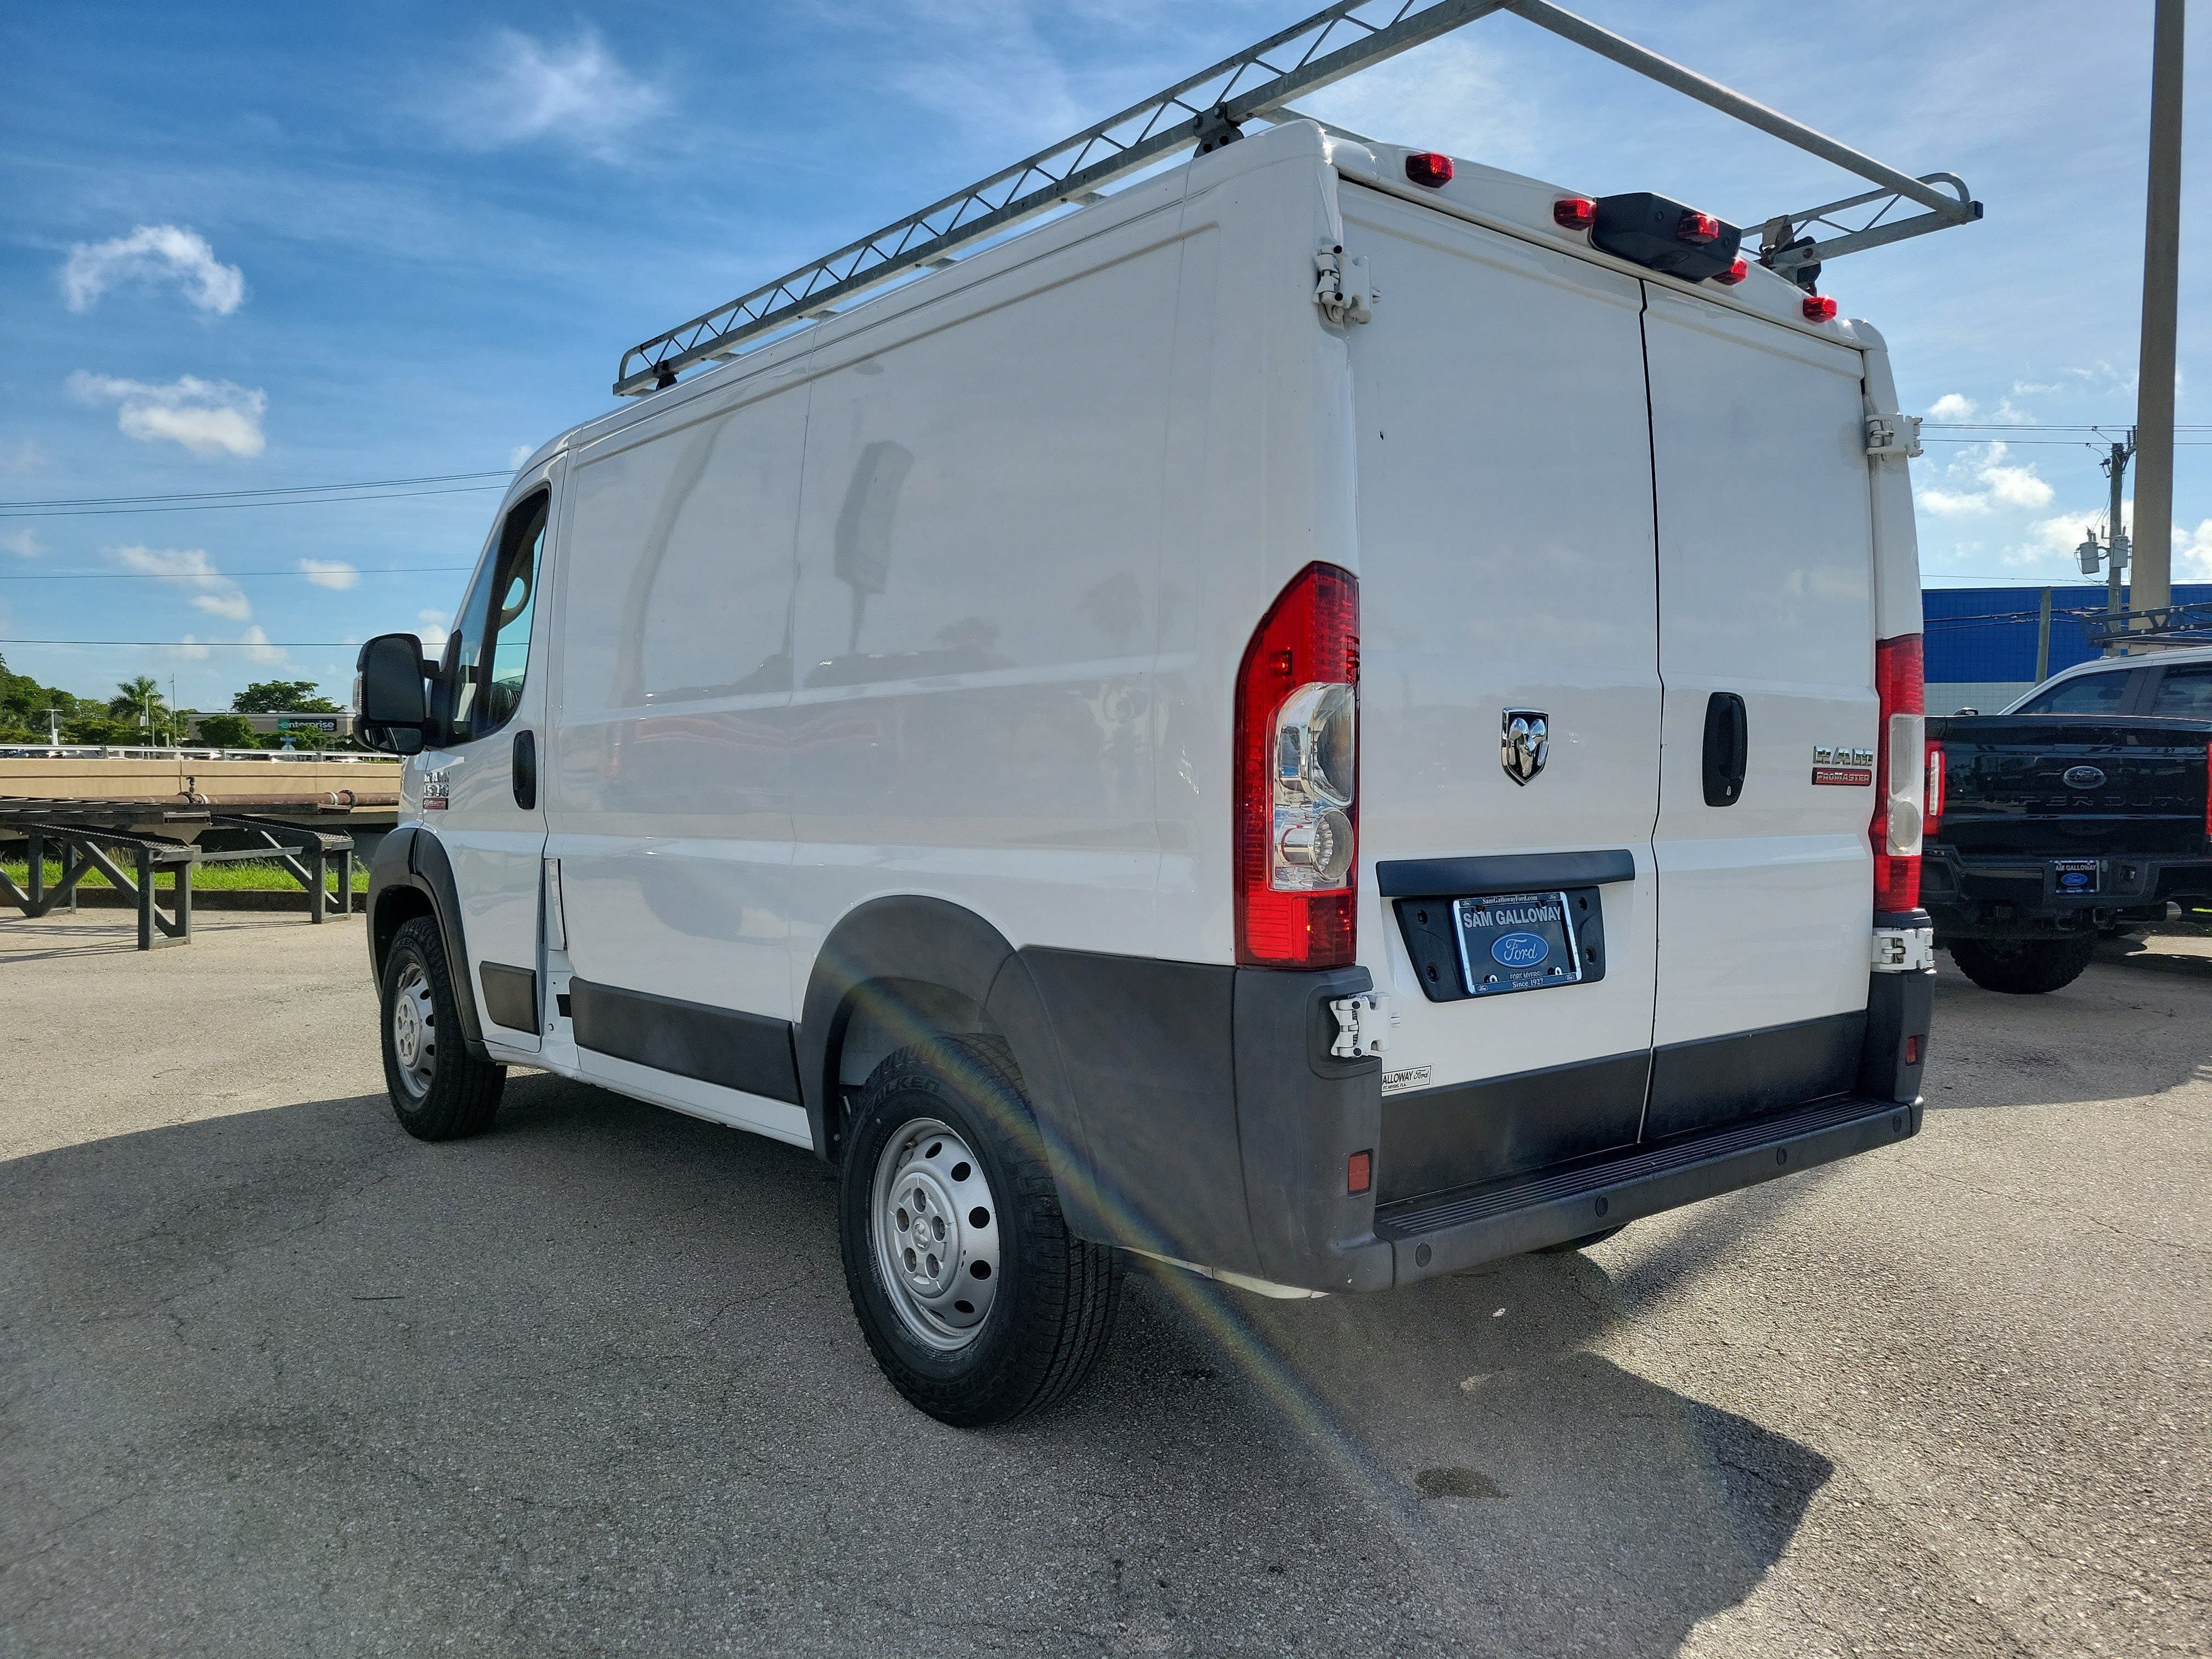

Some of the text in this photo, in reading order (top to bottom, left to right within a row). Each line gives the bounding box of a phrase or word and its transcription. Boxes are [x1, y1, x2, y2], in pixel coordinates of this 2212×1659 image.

[1813, 746, 1874, 766] RAM
[1482, 895, 1538, 905] SamGallowayFord.com
[1463, 906, 1561, 928] SAM GALLOWAY
[1504, 939, 1538, 961] Ford
[1382, 1069, 1430, 1085] ALLOWAY Ford
